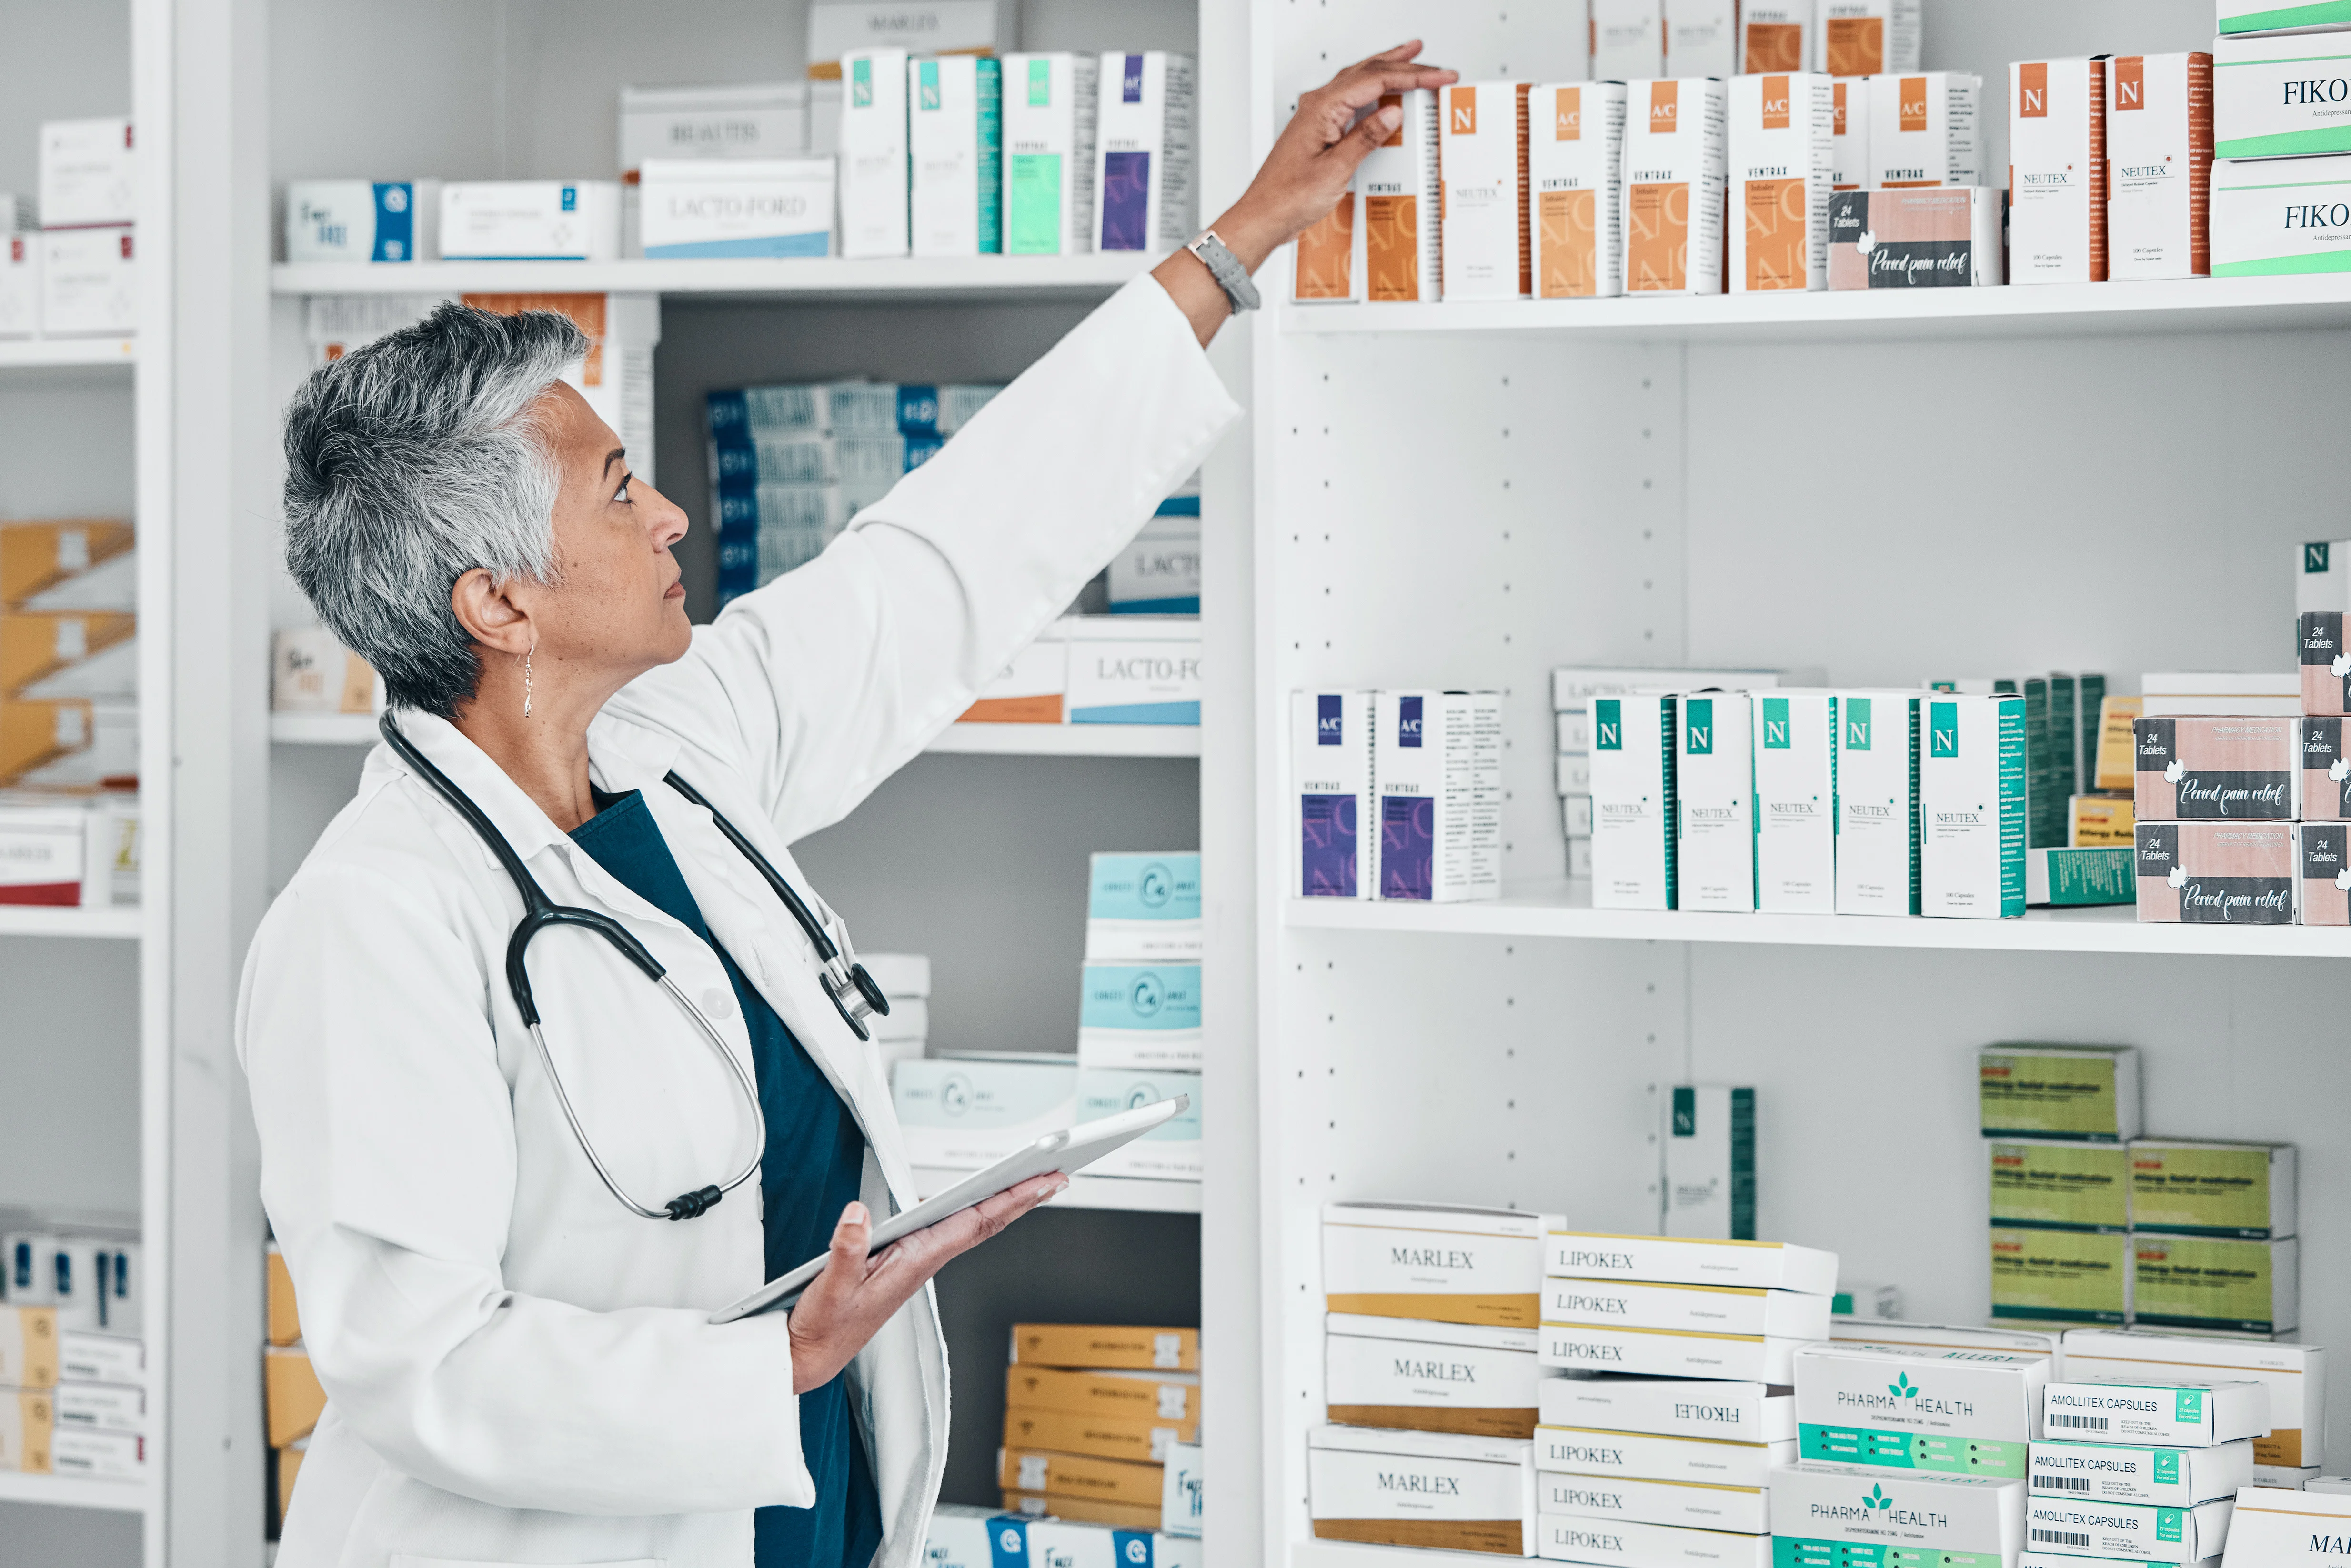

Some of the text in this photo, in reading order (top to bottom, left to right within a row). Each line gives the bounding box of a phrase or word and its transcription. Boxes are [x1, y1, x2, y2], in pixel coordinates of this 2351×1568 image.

[2024, 89, 2043, 111] N
[2120, 81, 2139, 104] N
[2283, 79, 2351, 104] FIKO
[1455, 108, 1472, 130] N
[2024, 174, 2067, 184] NEUTEX
[2121, 165, 2166, 178] NEUTEX
[1841, 205, 1852, 216] 24
[2284, 203, 2351, 229] FIKO
[1833, 216, 1860, 228] Tablets
[2309, 546, 2325, 568] N
[2312, 627, 2323, 637] 24
[2304, 639, 2333, 649] Tablets
[1601, 723, 1618, 744] N
[1691, 727, 1708, 749] N
[1768, 721, 1786, 742] N
[1849, 722, 1867, 744] N
[1935, 729, 1954, 751] N
[2147, 734, 2158, 743] 24
[2311, 731, 2323, 740] 24
[2139, 745, 2167, 755] Tablets
[2303, 743, 2332, 753] Tablets
[2180, 778, 2284, 815] Period pain relief
[1603, 805, 1643, 815] NEUTEX
[1692, 809, 1733, 819] NEUTEX
[1770, 803, 1814, 813] NEUTEX
[1849, 805, 1889, 817] NEUTEX
[1937, 813, 1979, 823] NEUTEX
[2149, 839, 2160, 849] 24
[2316, 840, 2328, 850] 24
[2141, 850, 2169, 860] Tablets
[2308, 852, 2337, 862] Tablets
[2184, 884, 2288, 920] Period pain relief
[1391, 1247, 1474, 1270] MARLEX
[1560, 1250, 1634, 1269] LIPOKEX
[1557, 1294, 1628, 1314] LIPOKEX
[1553, 1342, 1623, 1361] LIPOKEX
[1394, 1359, 1476, 1383] MARLEX
[1838, 1392, 1973, 1416] PHARMA HEALTH
[2051, 1395, 2158, 1412] AMOLLITEX CAPSULES
[1550, 1444, 1623, 1465] LIPOKEX
[2035, 1456, 2136, 1473] AMOLLITEX CAPSULES
[1377, 1472, 1460, 1496] MARLEX
[1553, 1488, 1623, 1508] LIPOKEX
[1811, 1504, 1947, 1528] PHARMA HEALTH
[2033, 1510, 2139, 1530] AMOLLITEX CAPSULES
[1555, 1529, 1623, 1551] LIPOKEX
